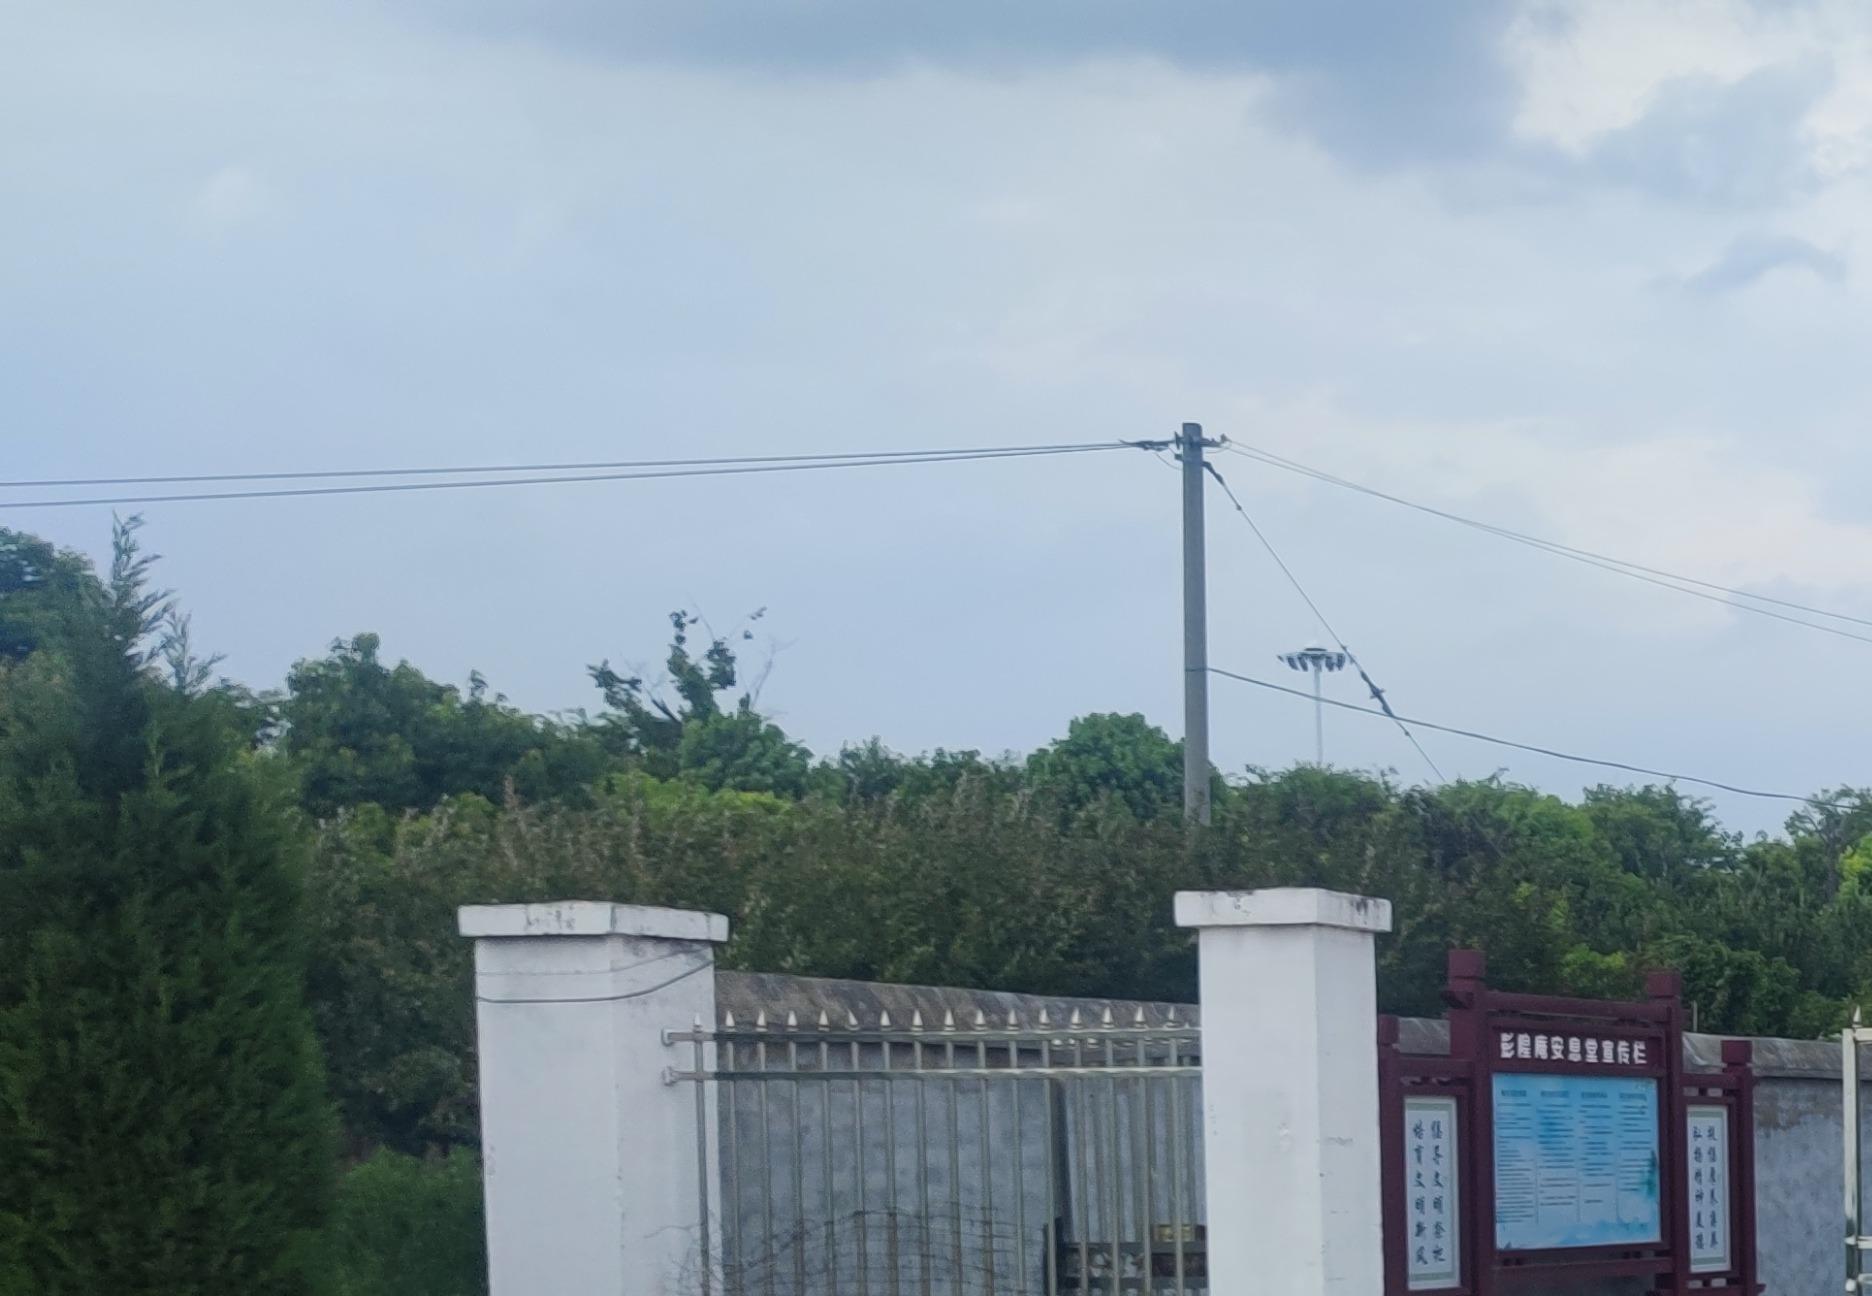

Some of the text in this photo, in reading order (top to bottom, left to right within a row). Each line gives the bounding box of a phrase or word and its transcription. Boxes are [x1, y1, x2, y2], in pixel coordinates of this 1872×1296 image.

[1499, 1032, 1648, 1065] 彭隍庵安息堂宣传栏
